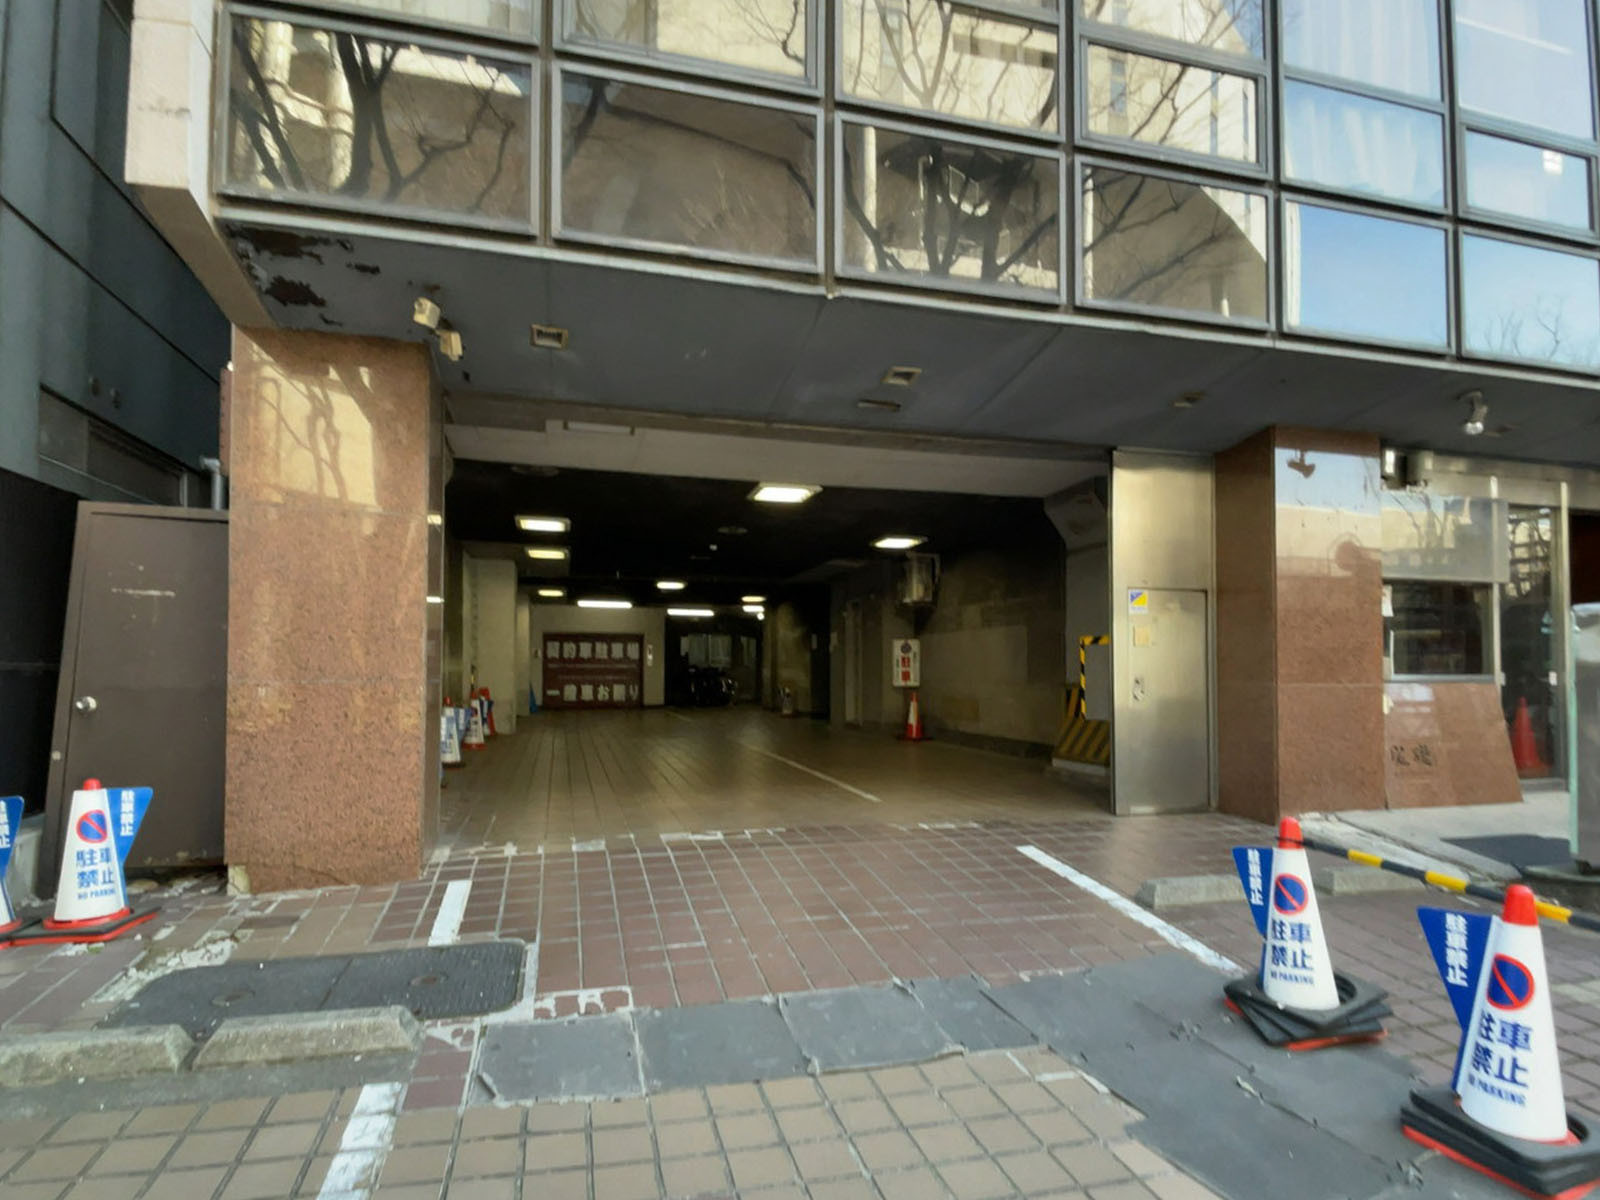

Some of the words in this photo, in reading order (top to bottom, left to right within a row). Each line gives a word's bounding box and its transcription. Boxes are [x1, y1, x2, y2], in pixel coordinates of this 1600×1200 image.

[76, 848, 110, 868] 駐車
[77, 867, 114, 888] 禁止
[1271, 919, 1312, 943] 駐車
[1271, 945, 1314, 970] 禁止
[1472, 1041, 1529, 1089] 禁止
